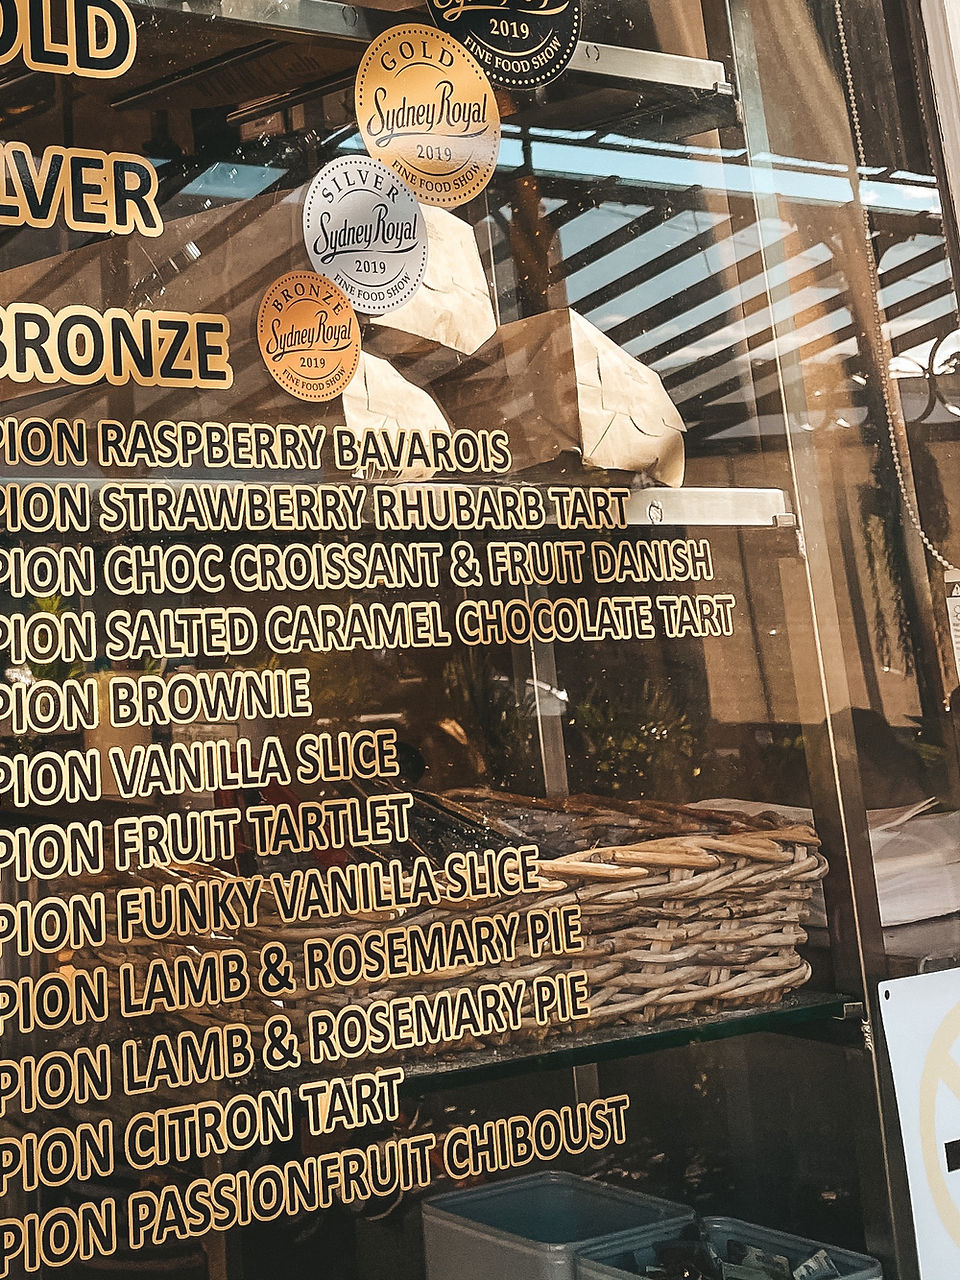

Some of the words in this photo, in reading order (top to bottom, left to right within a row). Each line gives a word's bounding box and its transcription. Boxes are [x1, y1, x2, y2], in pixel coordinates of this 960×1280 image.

[380, 39, 455, 71] GOLD
[463, 35, 493, 66] FINE
[495, 56, 531, 74] FOOD
[531, 35, 563, 70] SHOW
[489, 18, 530, 40] 2019
[367, 87, 437, 147] Sydney
[435, 80, 489, 137] Royal
[391, 158, 418, 187] FINE
[417, 174, 452, 193] FOOD
[452, 160, 482, 190] SHOW
[416, 144, 453, 162] 2019
[321, 169, 399, 205] SILVER
[314, 211, 373, 264] Sydney
[372, 203, 419, 253] Royal
[333, 272, 356, 296] FINE
[356, 288, 386, 302] FOOD
[386, 272, 413, 299] SHOW
[354, 259, 387, 275] 2019
[271, 282, 344, 317] BRONZE
[266, 319, 315, 362] Sydney
[314, 310, 352, 350] Royal
[299, 356, 327, 370] 2019
[282, 368, 301, 390] FINE
[300, 378, 326, 392] FOOD
[325, 367, 348, 390] SHOW
[98, 418, 327, 471] RASPBERRY
[335, 426, 512, 475] BAVAROIS
[98, 483, 367, 533] STRAWBERRY
[372, 485, 545, 531] RHUBARB
[548, 486, 631, 531] TART
[103, 543, 226, 596] CHOC
[231, 541, 444, 592] CROISSANT
[449, 540, 482, 588] &
[486, 540, 586, 587] FRUIT
[590, 538, 714, 584] DANISH
[105, 605, 257, 661] SALTED
[264, 600, 452, 654] CARAMEL
[455, 595, 655, 647] CHOCOLATE
[656, 594, 737, 639] TART
[109, 669, 313, 728] BROWNIE
[109, 735, 291, 800] VANILLA
[296, 729, 400, 782] SLICE
[114, 807, 242, 872] FRUIT
[246, 792, 415, 857] TARTLET
[116, 876, 264, 944] FUNKY
[269, 854, 441, 922] VANILLA
[444, 844, 541, 901] SLICE
[118, 949, 250, 1018] LAMB
[258, 941, 295, 996] &
[304, 914, 521, 991] ROSEMARY
[525, 906, 586, 959] PIE
[121, 1025, 254, 1097] LAMB
[262, 1015, 301, 1071] &
[308, 980, 527, 1064] ROSEMARY
[532, 969, 592, 1026] PIE
[124, 1087, 294, 1170] CITRON
[299, 1066, 406, 1136] TART
[128, 1132, 437, 1251] PASSIONFRUIT
[442, 1094, 632, 1182] CHIBOUST
